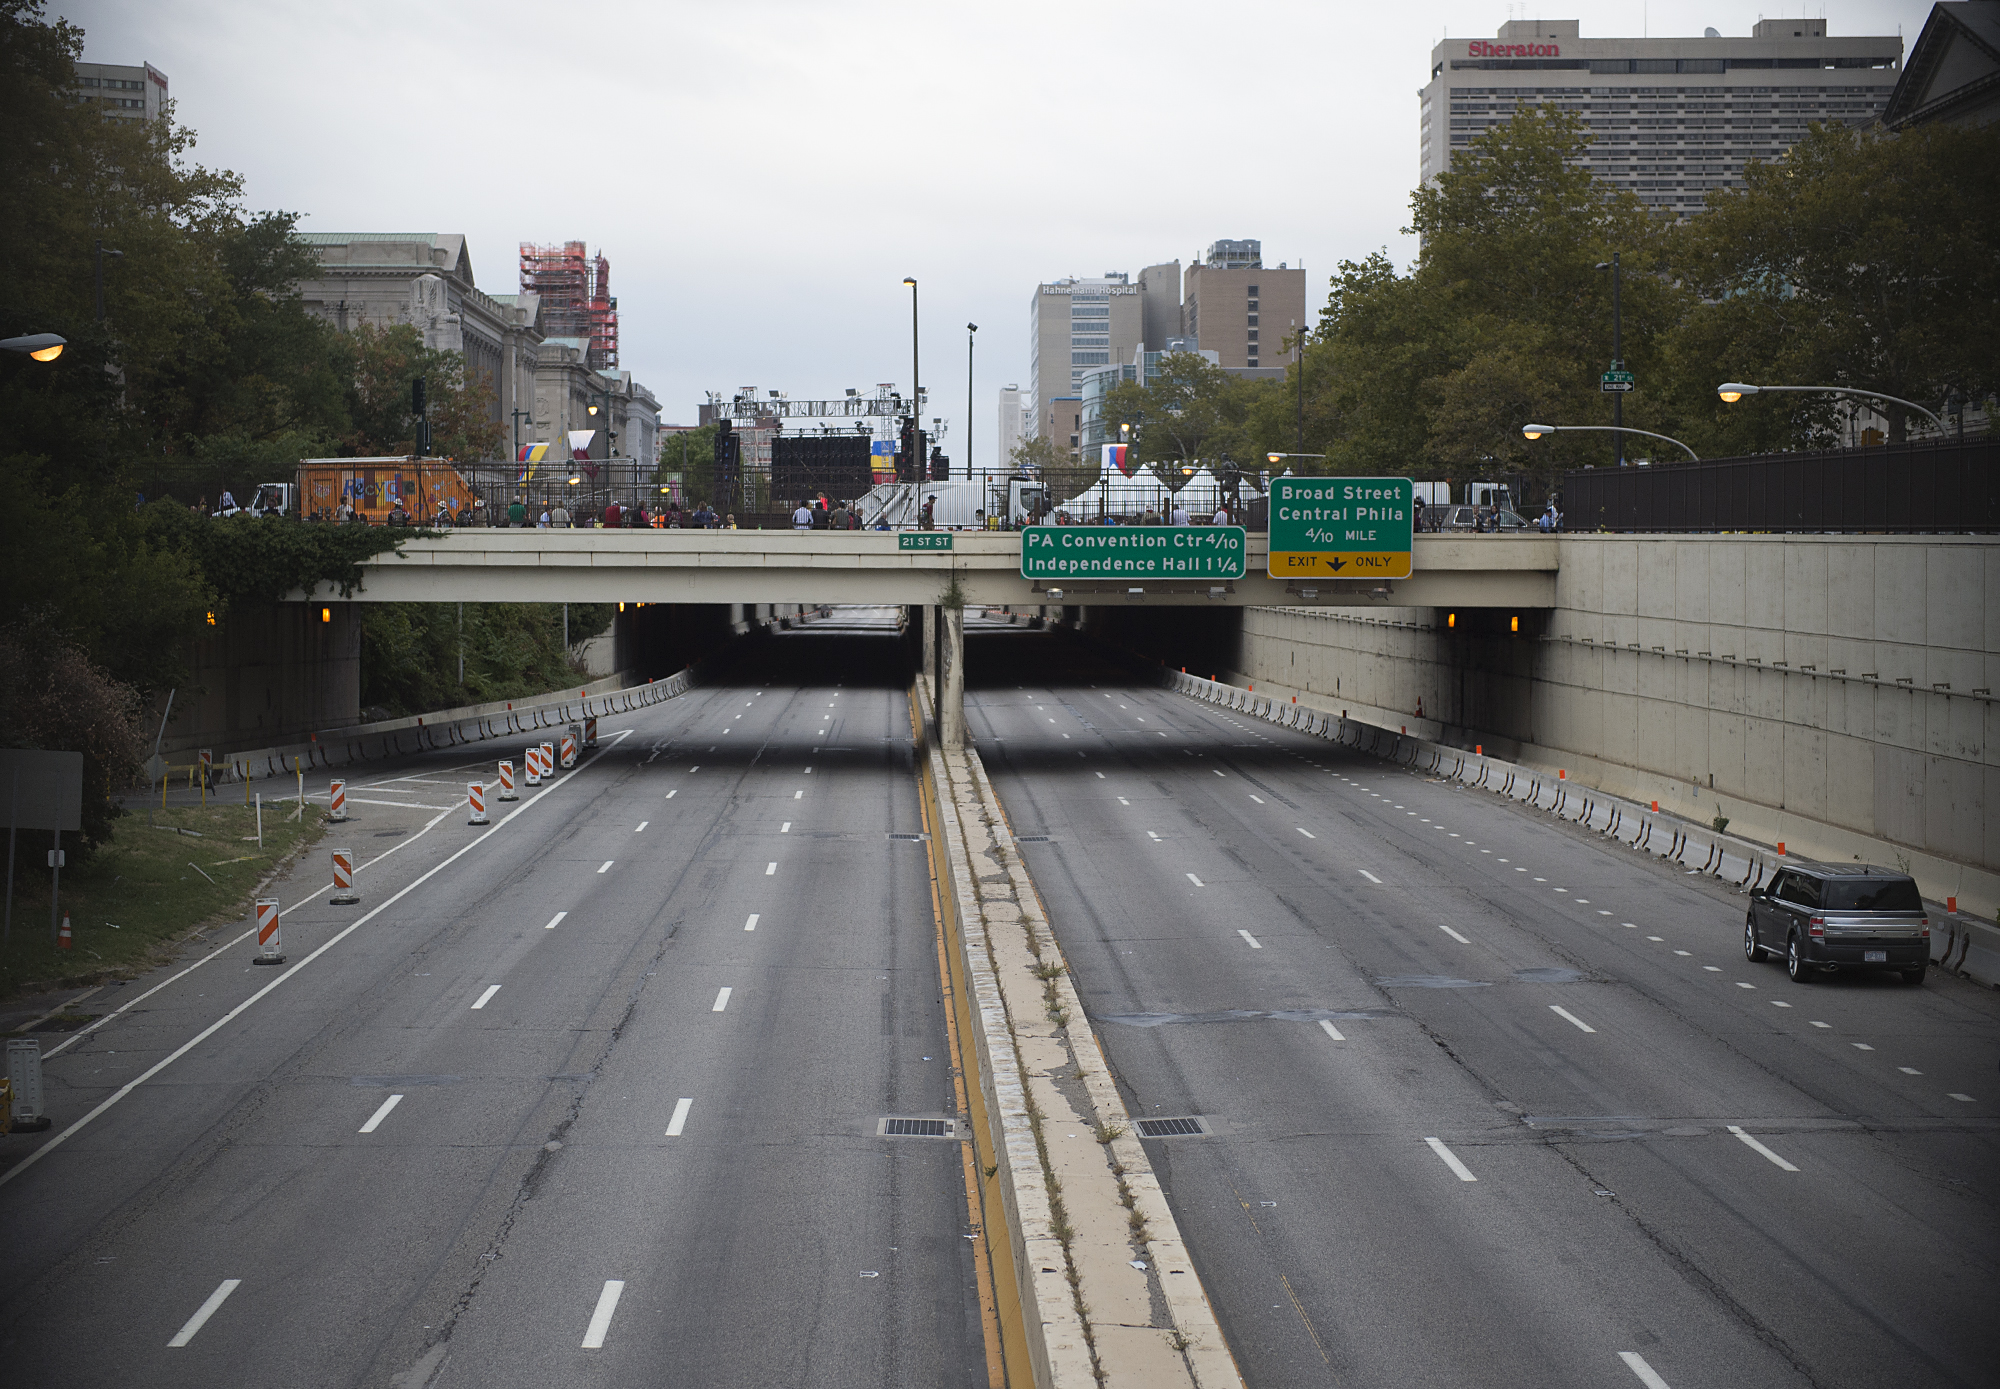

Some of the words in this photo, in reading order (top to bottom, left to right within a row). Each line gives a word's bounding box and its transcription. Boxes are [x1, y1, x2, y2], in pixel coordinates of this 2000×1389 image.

[1469, 41, 1559, 57] Sheraton
[1043, 286, 1096, 295] Hahnemann
[1100, 286, 1137, 296] Hospital
[1282, 486, 1334, 500] Broad
[1343, 486, 1401, 500] Street
[1279, 507, 1347, 520] Central
[1356, 507, 1403, 520] Phila
[935, 537, 949, 546] ST
[1028, 533, 1054, 547] PA
[1062, 533, 1167, 547] Convention
[1173, 533, 1203, 547] Ctr
[1205, 533, 1238, 549] 4/10
[1305, 528, 1334, 543] 4/10
[1345, 530, 1377, 541] MILE
[1028, 557, 1156, 574] Independence
[1163, 557, 1199, 571] Hall
[1288, 556, 1318, 567] EXIT
[1355, 556, 1392, 567] ONLY
